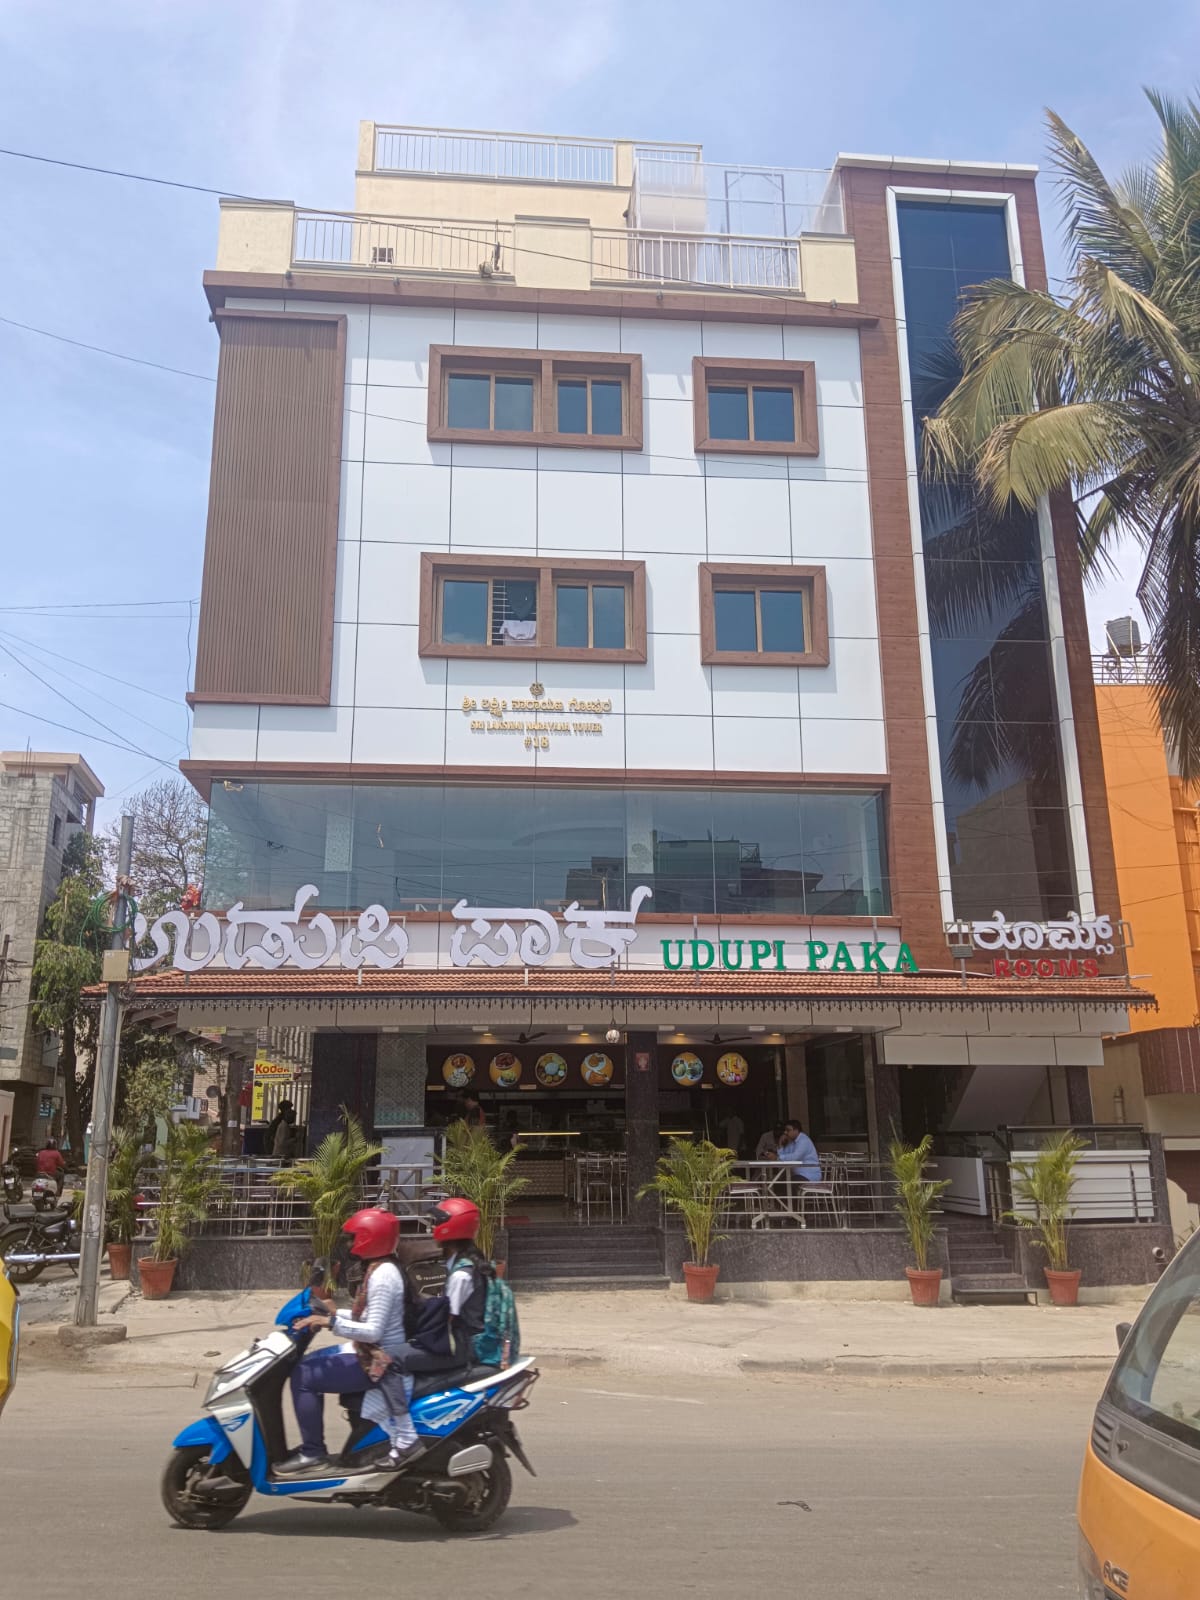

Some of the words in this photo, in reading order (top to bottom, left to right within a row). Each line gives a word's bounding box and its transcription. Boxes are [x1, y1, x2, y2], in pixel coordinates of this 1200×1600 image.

[470, 720, 484, 731] SRI
[125, 884, 410, 971] ಉಡುಪಿ
[660, 939, 785, 971] UDUPI
[805, 940, 920, 973] PAKA
[993, 958, 1099, 977] ROOMS
